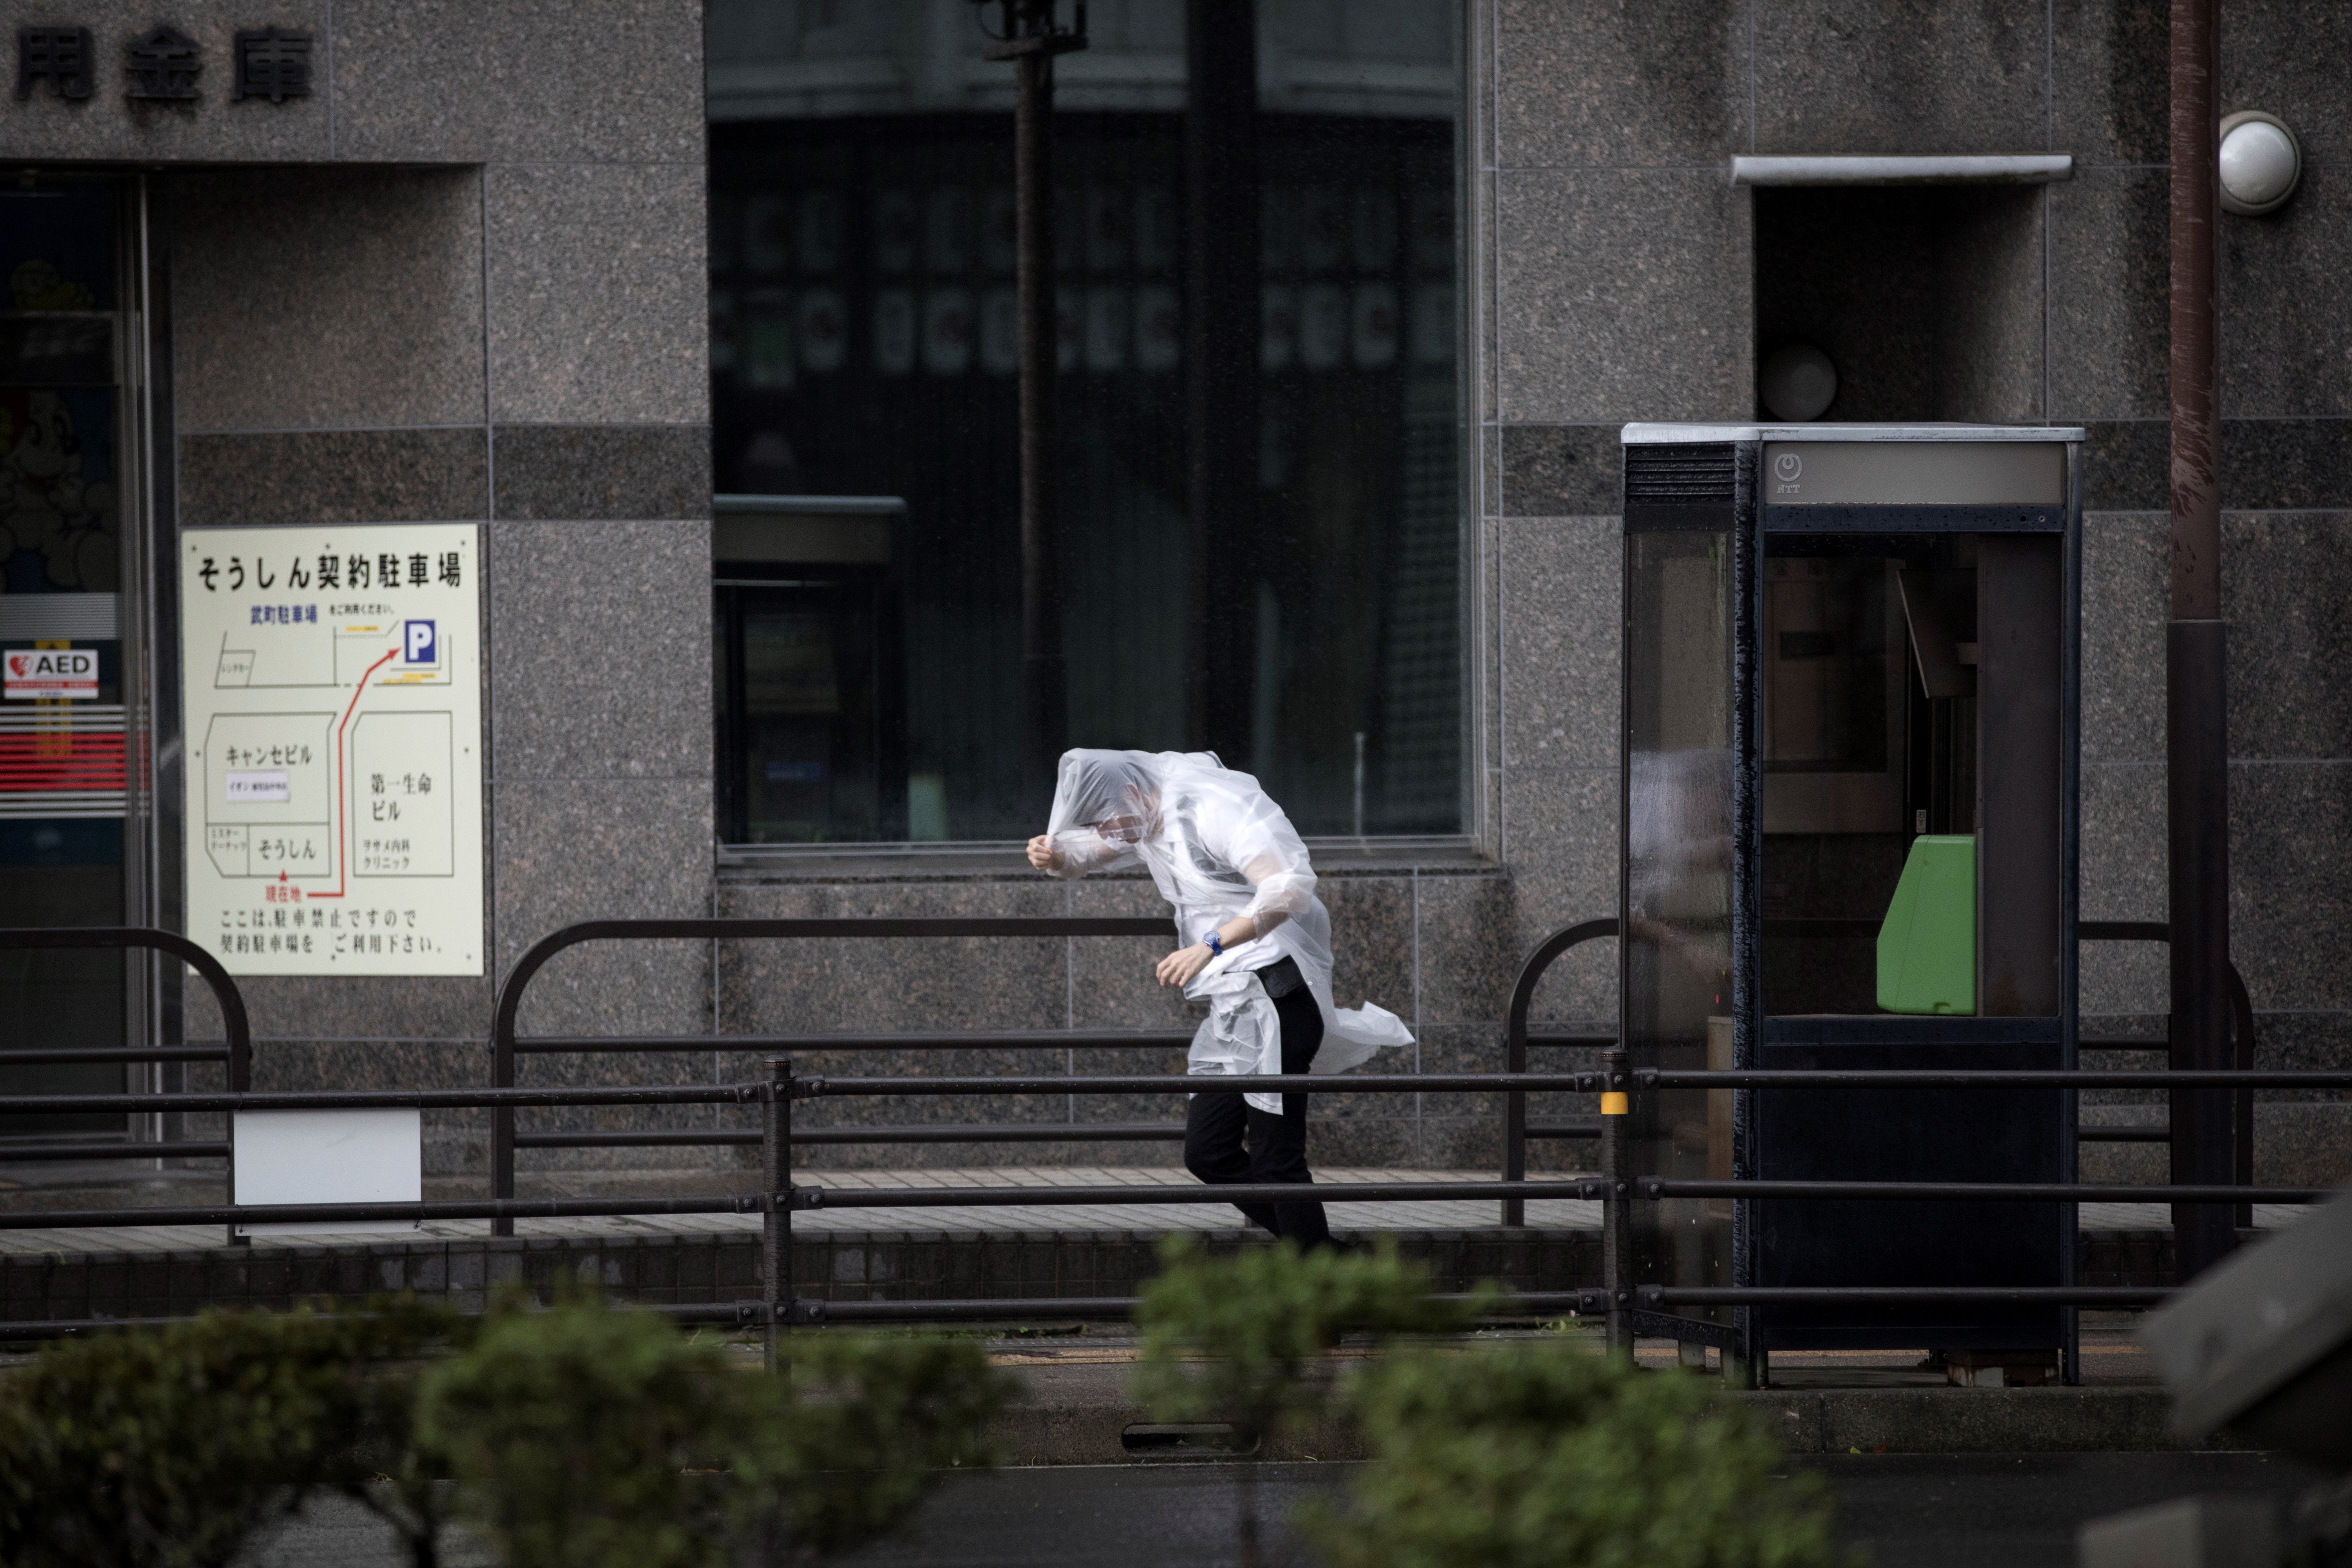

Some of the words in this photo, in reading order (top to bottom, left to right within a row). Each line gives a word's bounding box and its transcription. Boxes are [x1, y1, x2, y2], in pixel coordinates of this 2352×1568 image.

[1777, 484, 1800, 493] NTT
[199, 552, 460, 590] そうしん契約駐車場
[409, 624, 433, 660] P
[36, 656, 90, 673] AED
[227, 745, 312, 767] キャンセビル
[371, 772, 431, 795] 第一生命
[372, 800, 401, 821] ビル
[259, 839, 316, 860] そうしん
[266, 885, 301, 903] 現在地
